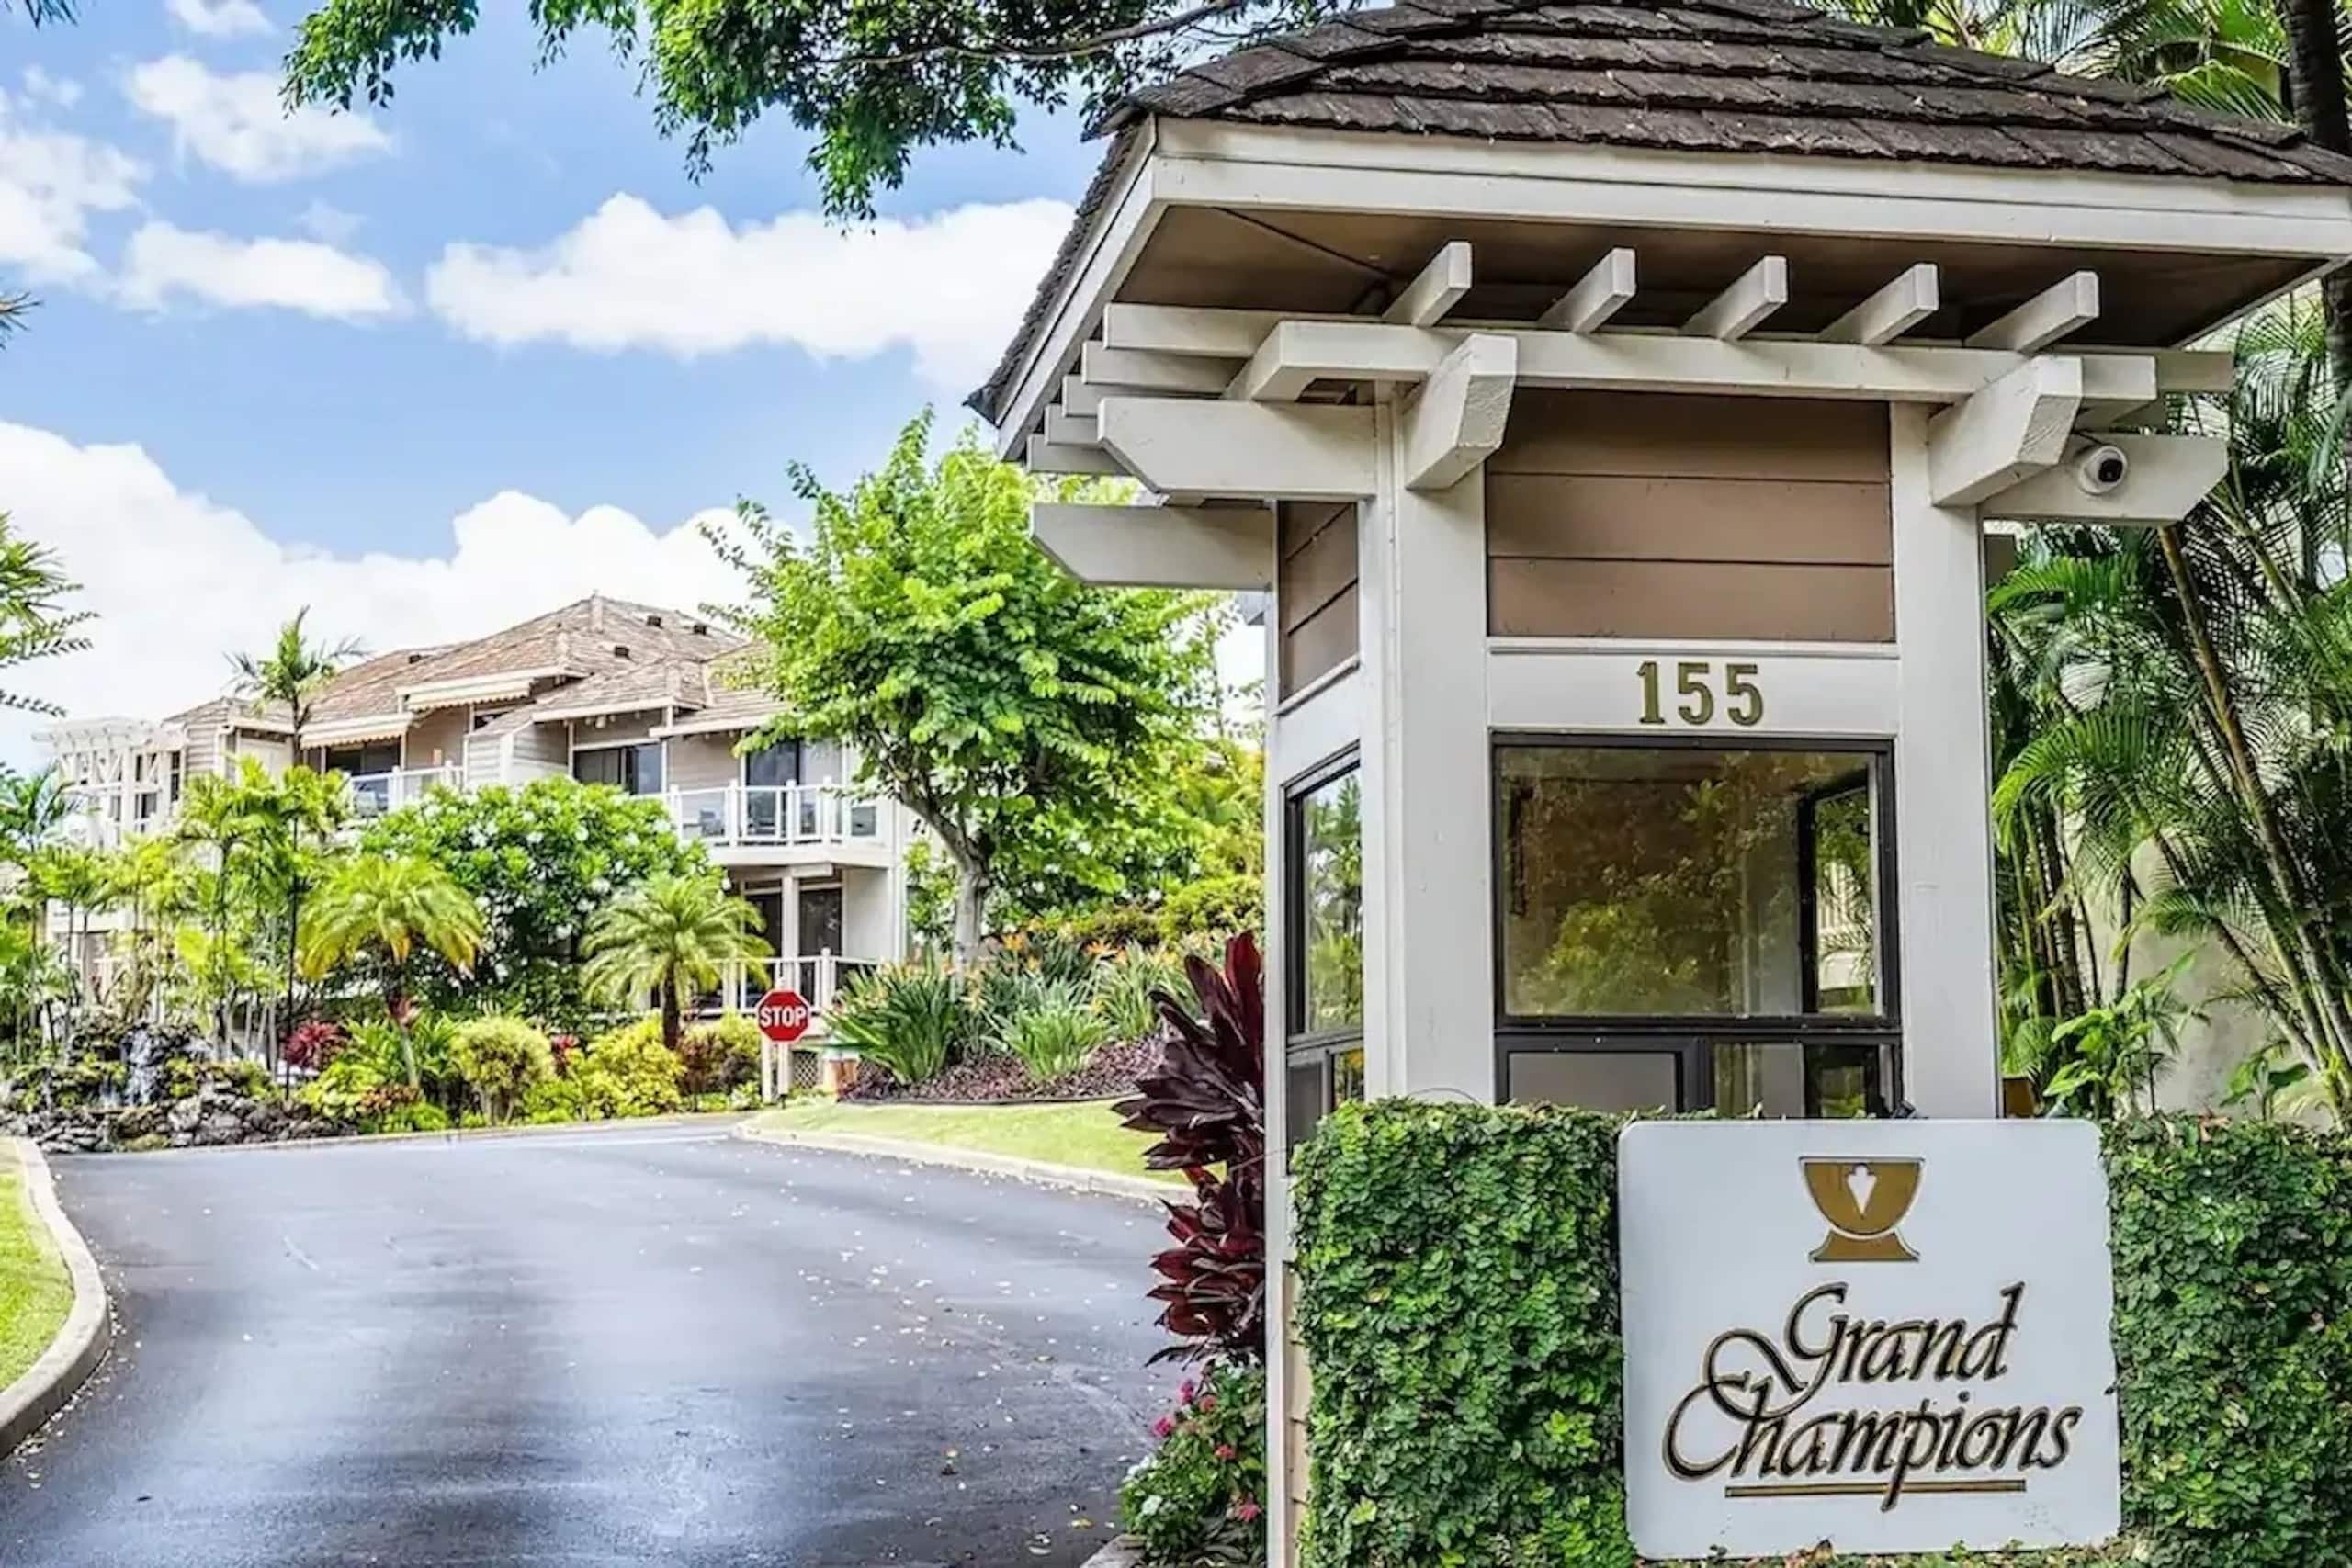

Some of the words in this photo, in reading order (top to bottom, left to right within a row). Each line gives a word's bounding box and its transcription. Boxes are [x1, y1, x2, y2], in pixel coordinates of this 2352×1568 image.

[1636, 660, 1764, 727] 155
[760, 1005, 807, 1028] STOP
[1702, 1280, 2026, 1420] Grand
[1661, 1371, 2084, 1513] Champions
